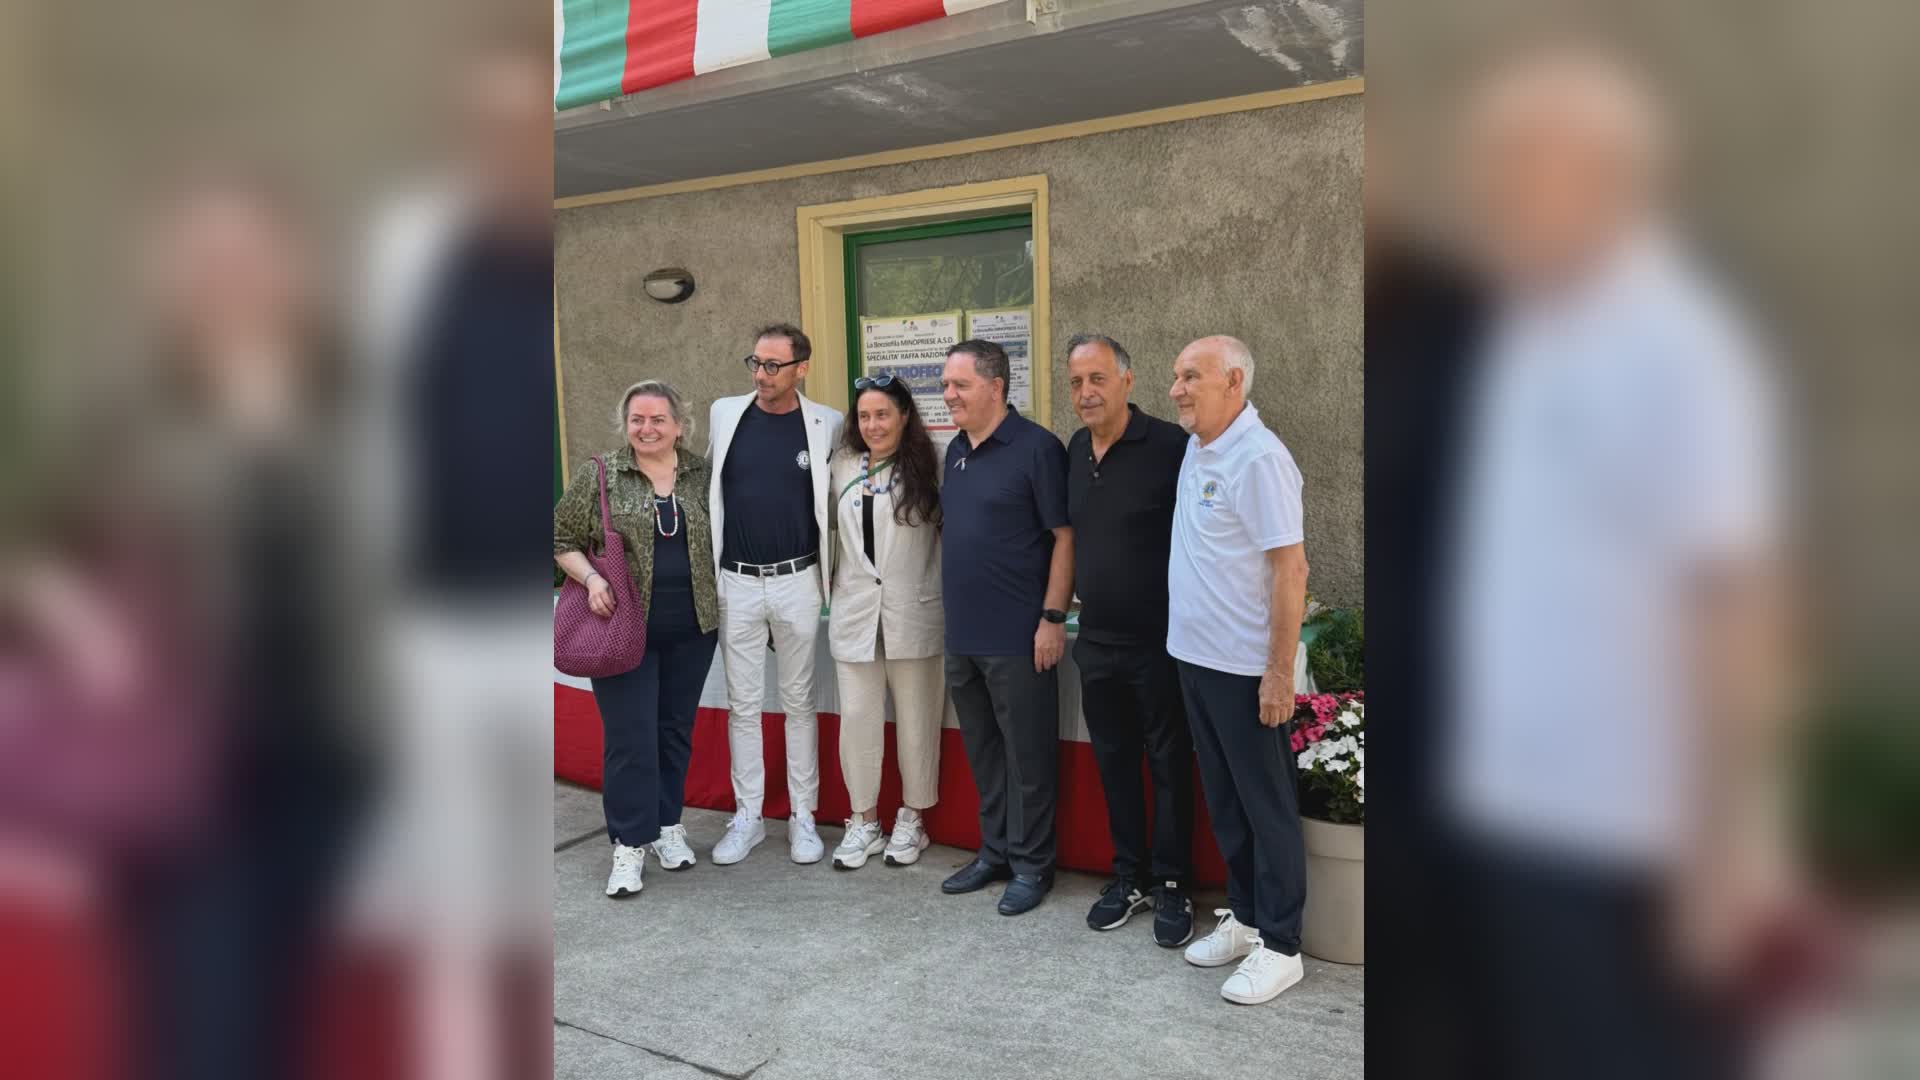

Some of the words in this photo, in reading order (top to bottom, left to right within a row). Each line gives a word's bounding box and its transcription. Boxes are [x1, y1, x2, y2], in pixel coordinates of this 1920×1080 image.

[866, 341, 873, 349] La
[901, 338, 936, 346] MINOPRIESE
[937, 336, 954, 344] A.S.D.
[901, 352, 919, 360] RAFFA
[920, 351, 949, 359] NAZIONA
[896, 365, 943, 378] TROFEO
